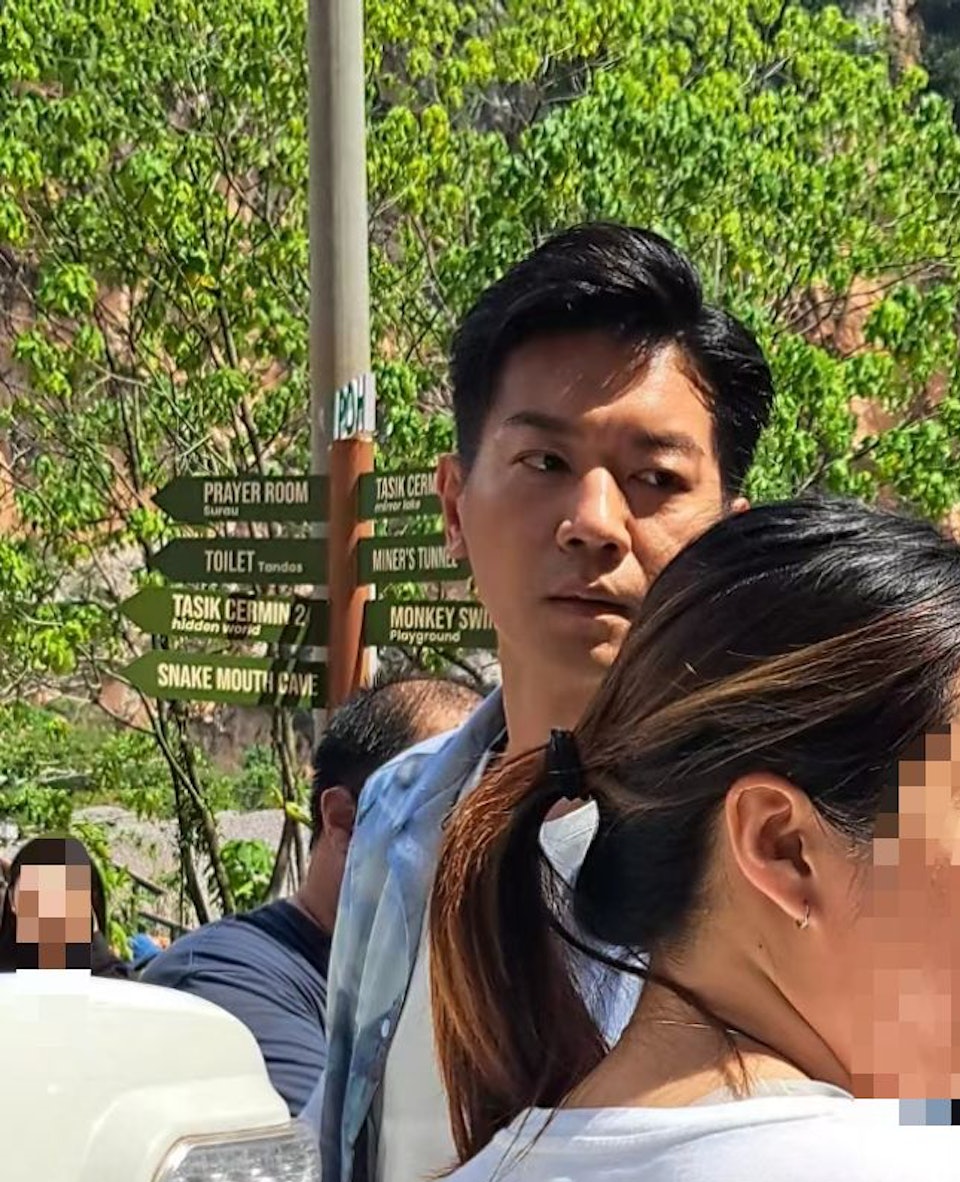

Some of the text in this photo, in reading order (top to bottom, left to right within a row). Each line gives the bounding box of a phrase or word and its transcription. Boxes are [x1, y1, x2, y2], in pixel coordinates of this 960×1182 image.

[204, 481, 309, 504] PRAYER ROOM
[375, 472, 438, 500] TASIK CERM
[203, 506, 240, 516] Surau
[402, 499, 421, 510] lake
[204, 550, 303, 573] TOILET Tandas
[373, 547, 416, 571] MINER'S
[172, 593, 222, 620] TASIK
[225, 599, 291, 626] CERMIN
[390, 606, 456, 629] MONKEY
[171, 617, 262, 636] hidden world
[390, 629, 462, 645] Playground
[157, 662, 319, 697] SNAKE MOUTH CAVE
